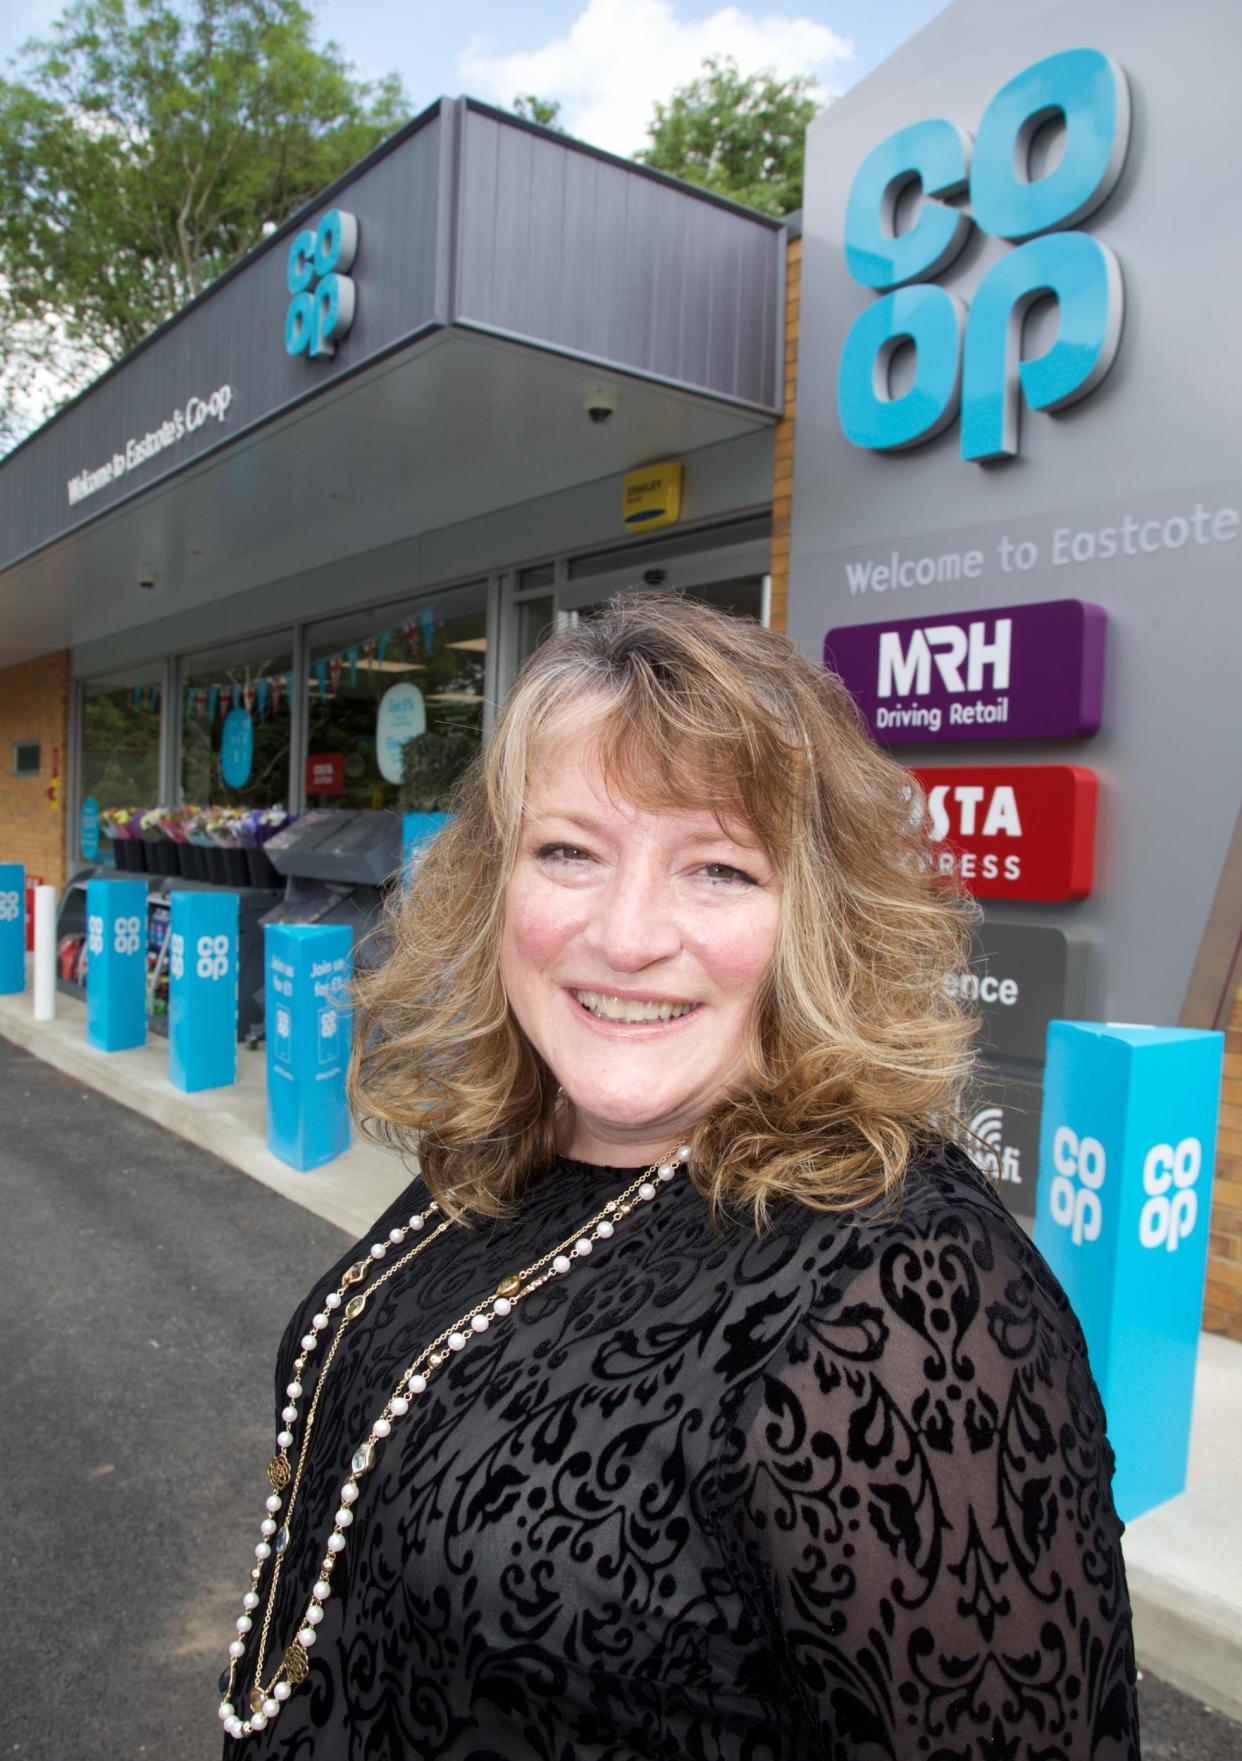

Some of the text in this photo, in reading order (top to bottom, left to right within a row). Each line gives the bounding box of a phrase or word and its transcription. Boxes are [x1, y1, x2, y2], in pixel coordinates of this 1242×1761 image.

[185, 384, 232, 433] Co-op
[846, 502, 1239, 595] Welcome to Eastcote
[877, 618, 1012, 698] MRH
[876, 696, 1009, 732] Driving Retail
